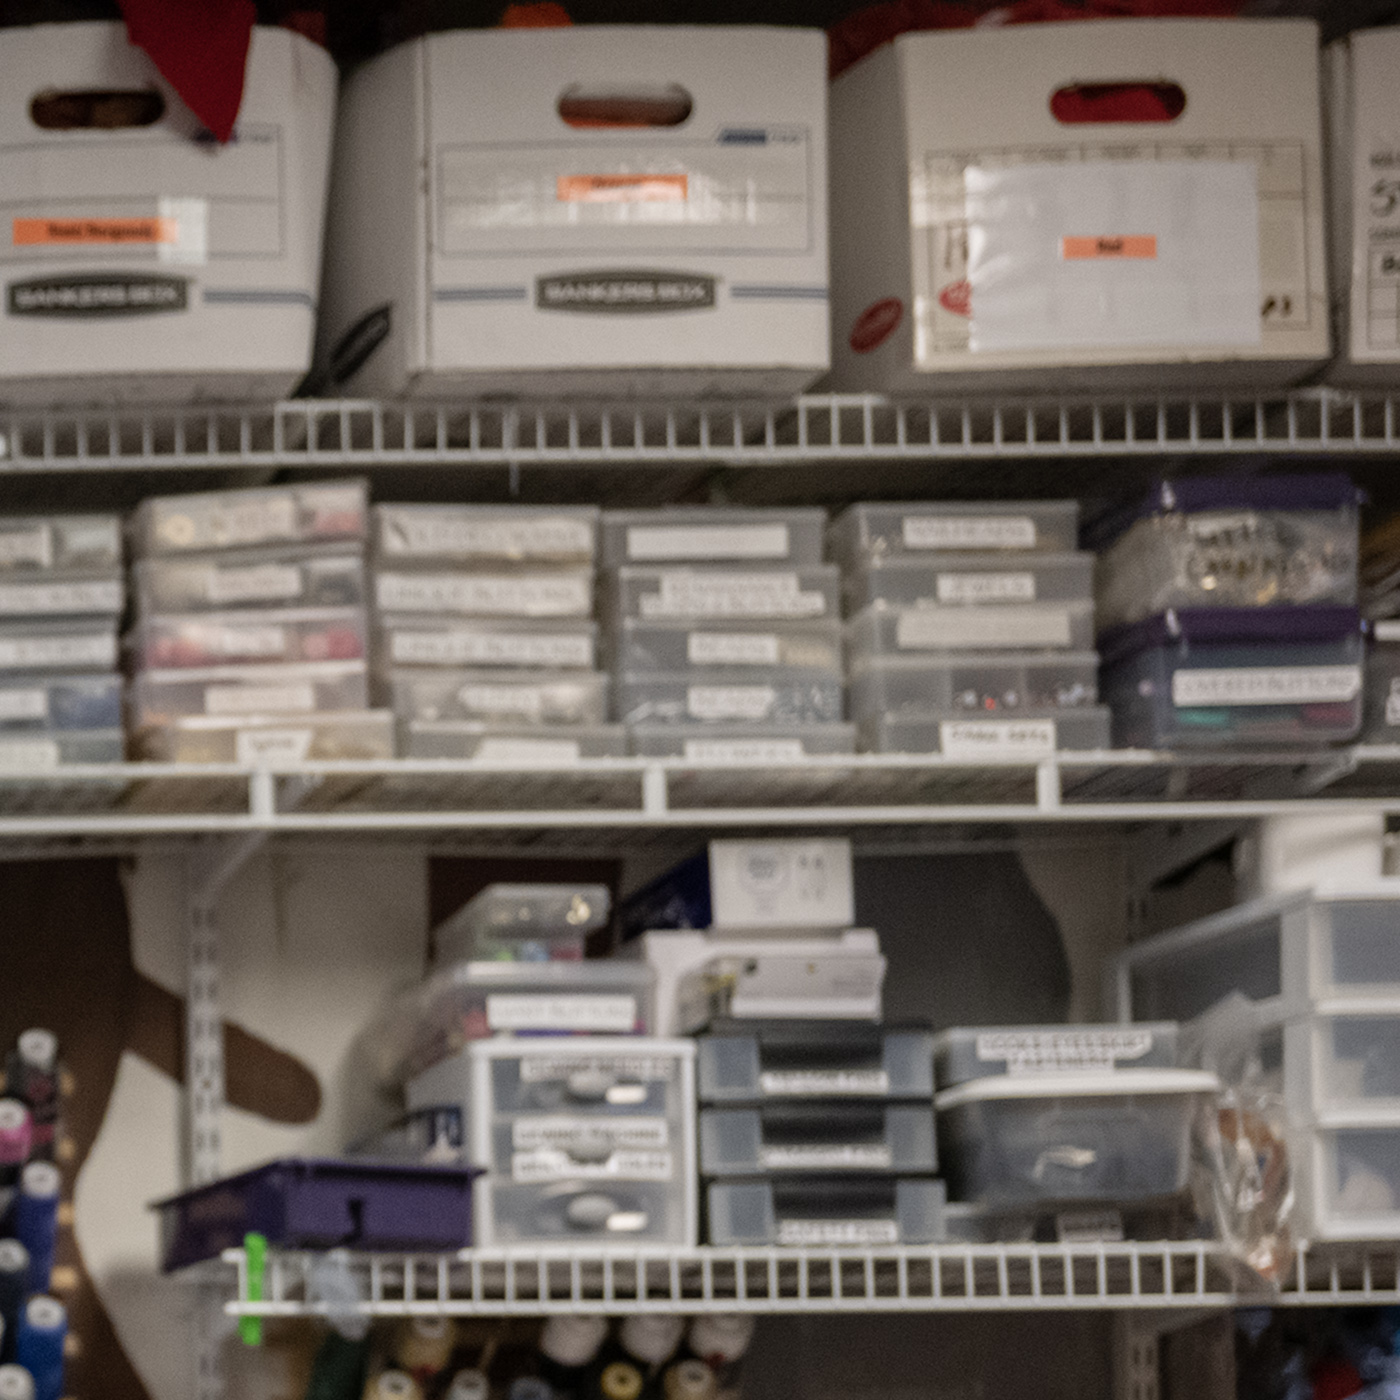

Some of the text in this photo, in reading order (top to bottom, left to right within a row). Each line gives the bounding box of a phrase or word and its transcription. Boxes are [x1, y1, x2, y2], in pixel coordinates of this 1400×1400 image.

[15, 284, 177, 308] BANKERS BOX
[544, 283, 706, 302] BANKERS BOX
